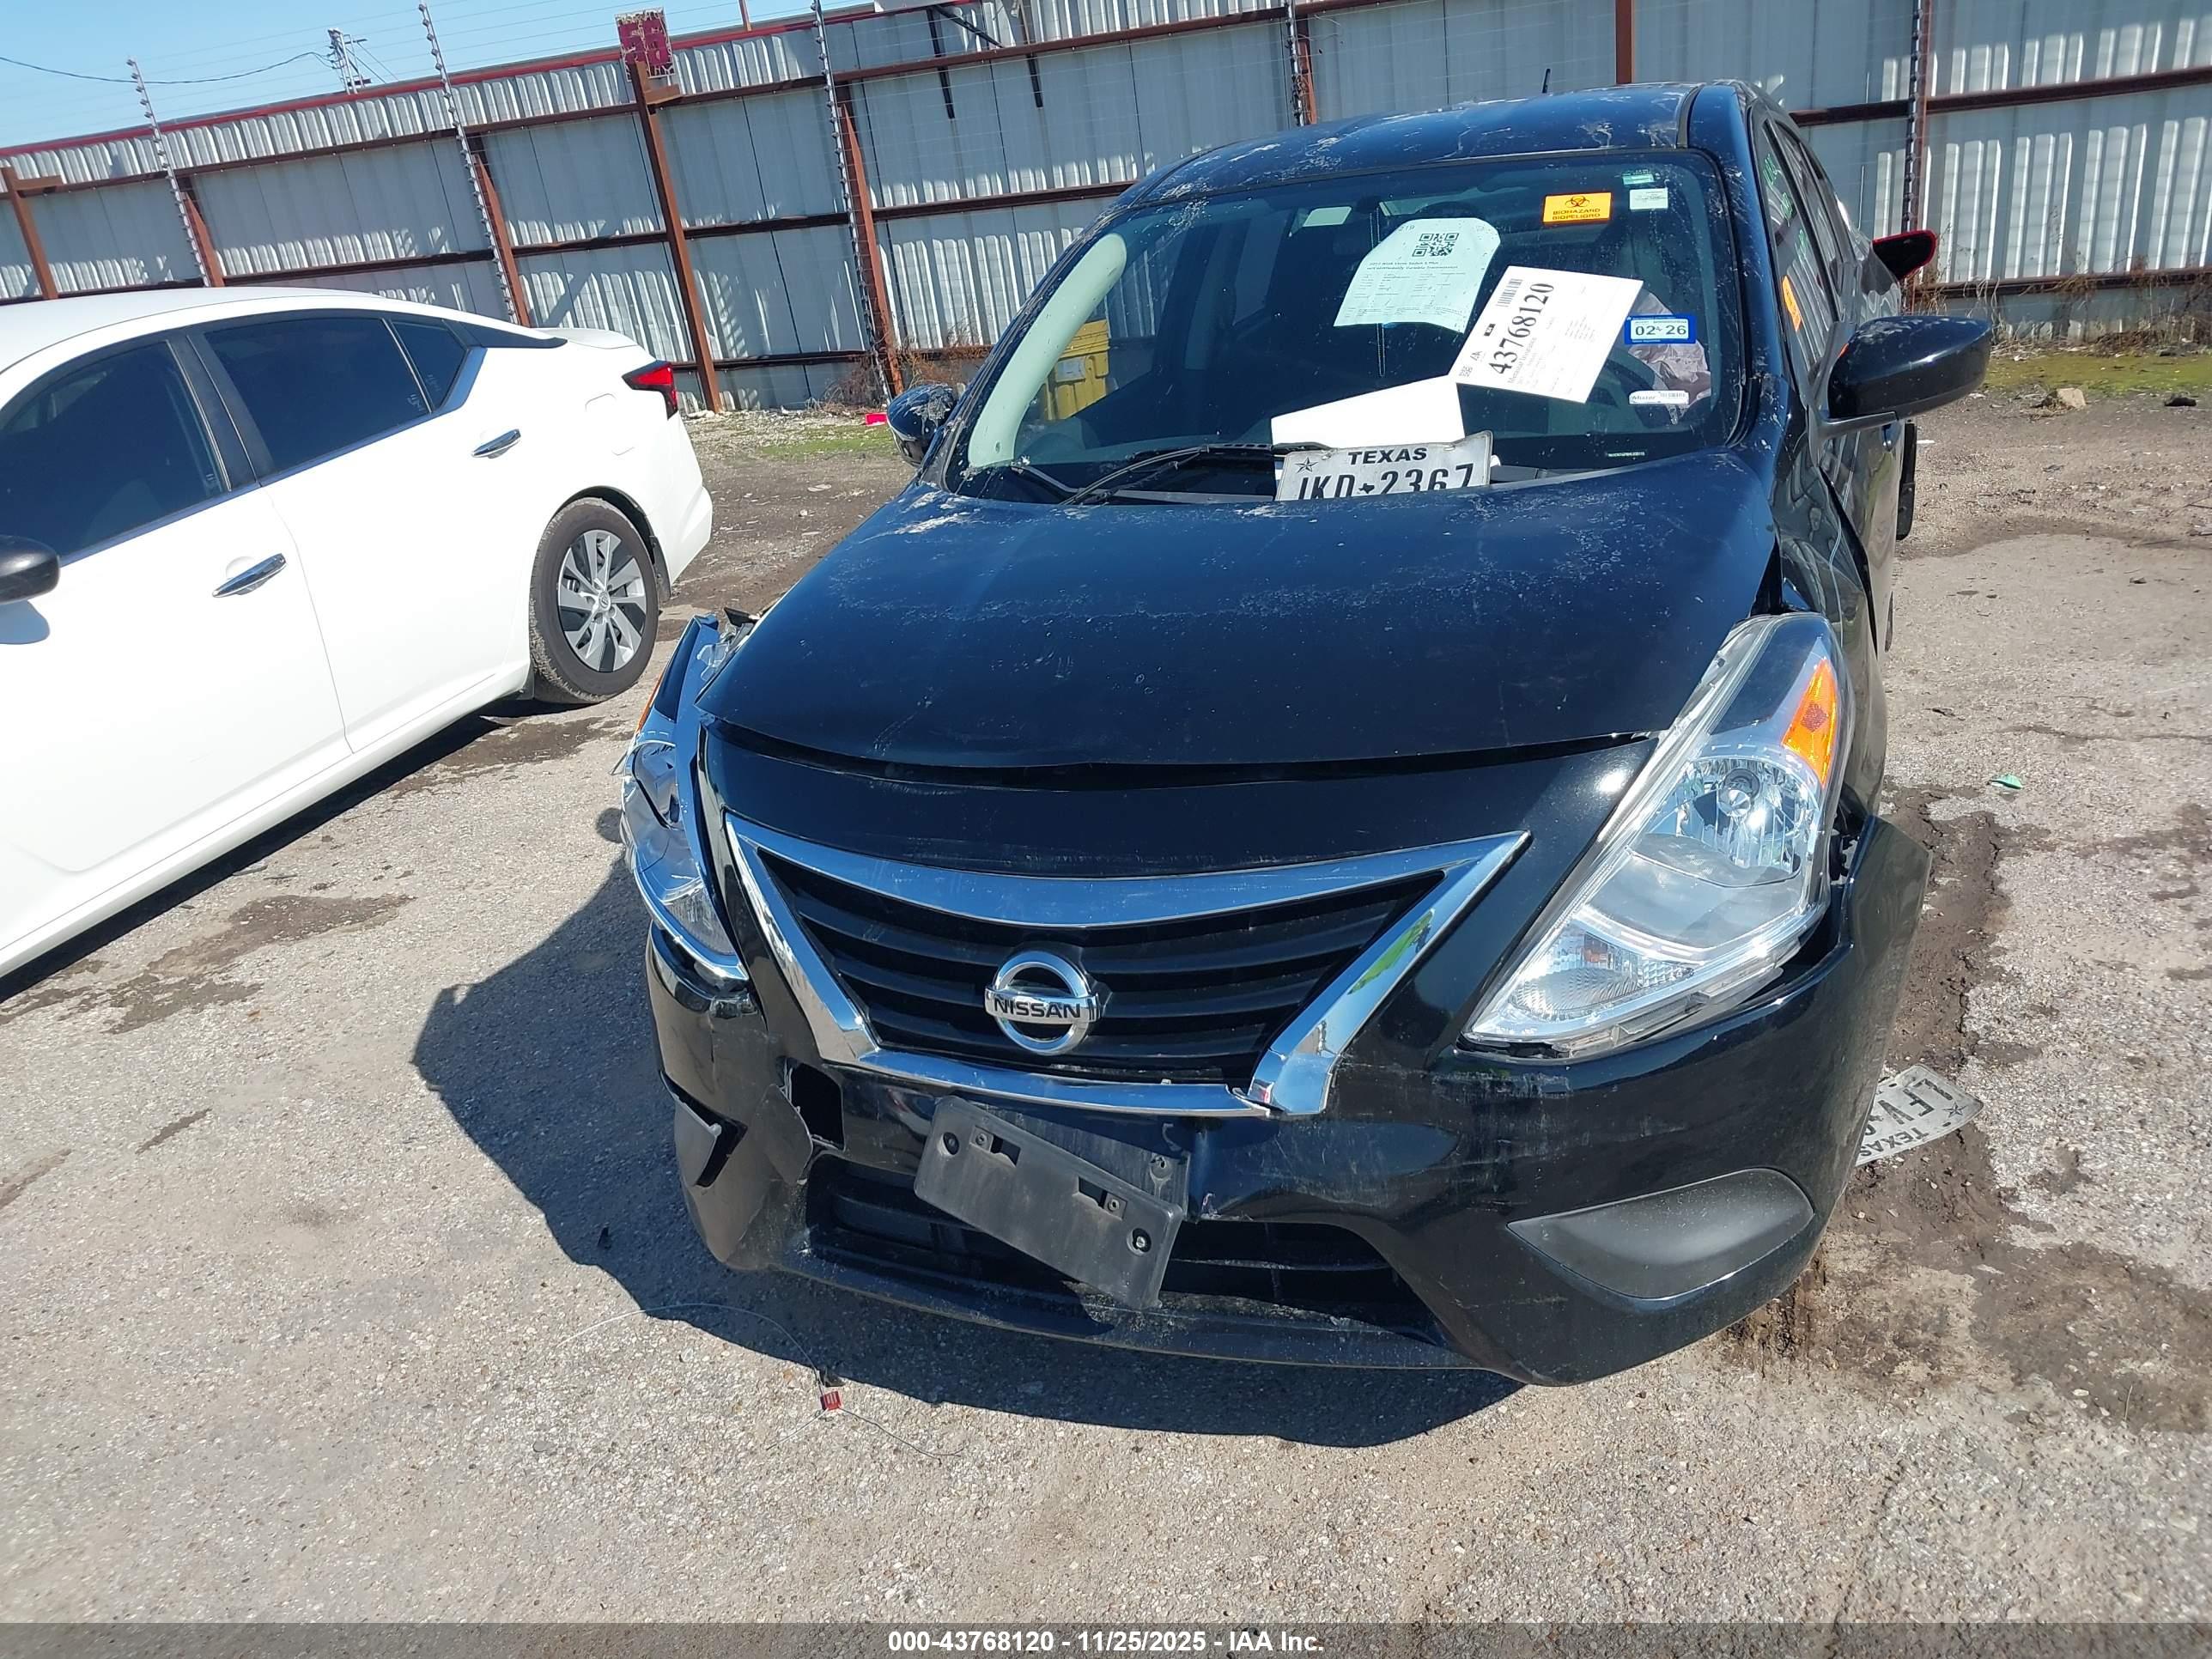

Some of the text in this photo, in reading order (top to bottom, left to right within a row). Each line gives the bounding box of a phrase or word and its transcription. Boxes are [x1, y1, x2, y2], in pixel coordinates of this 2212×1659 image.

[1489, 283, 1554, 374] 43768120
[1635, 325, 1686, 336] 02 26
[1347, 447, 1428, 465] TEXAS
[994, 996, 1081, 1018] NISSAN
[1858, 1127, 1929, 1157] TEXAS
